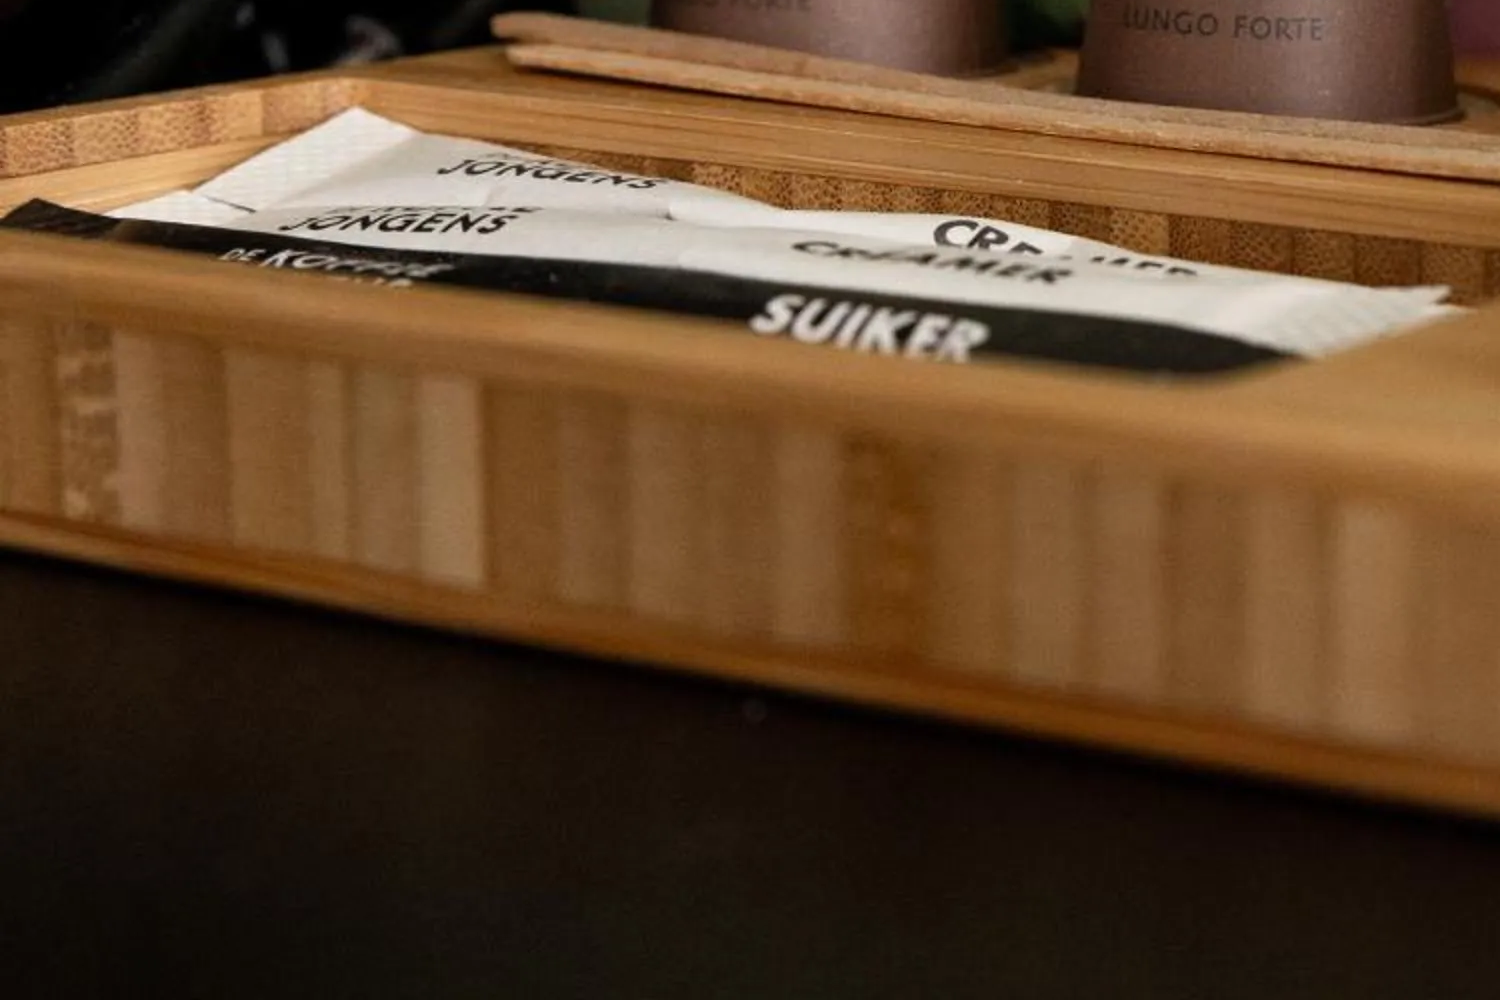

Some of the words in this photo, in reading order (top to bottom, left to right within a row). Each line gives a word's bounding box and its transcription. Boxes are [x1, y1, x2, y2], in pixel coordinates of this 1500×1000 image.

[1233, 14, 1324, 42] FORTE
[437, 158, 669, 189] JONGENS
[278, 211, 521, 235] JONGENS
[749, 293, 991, 364] SUIKER
